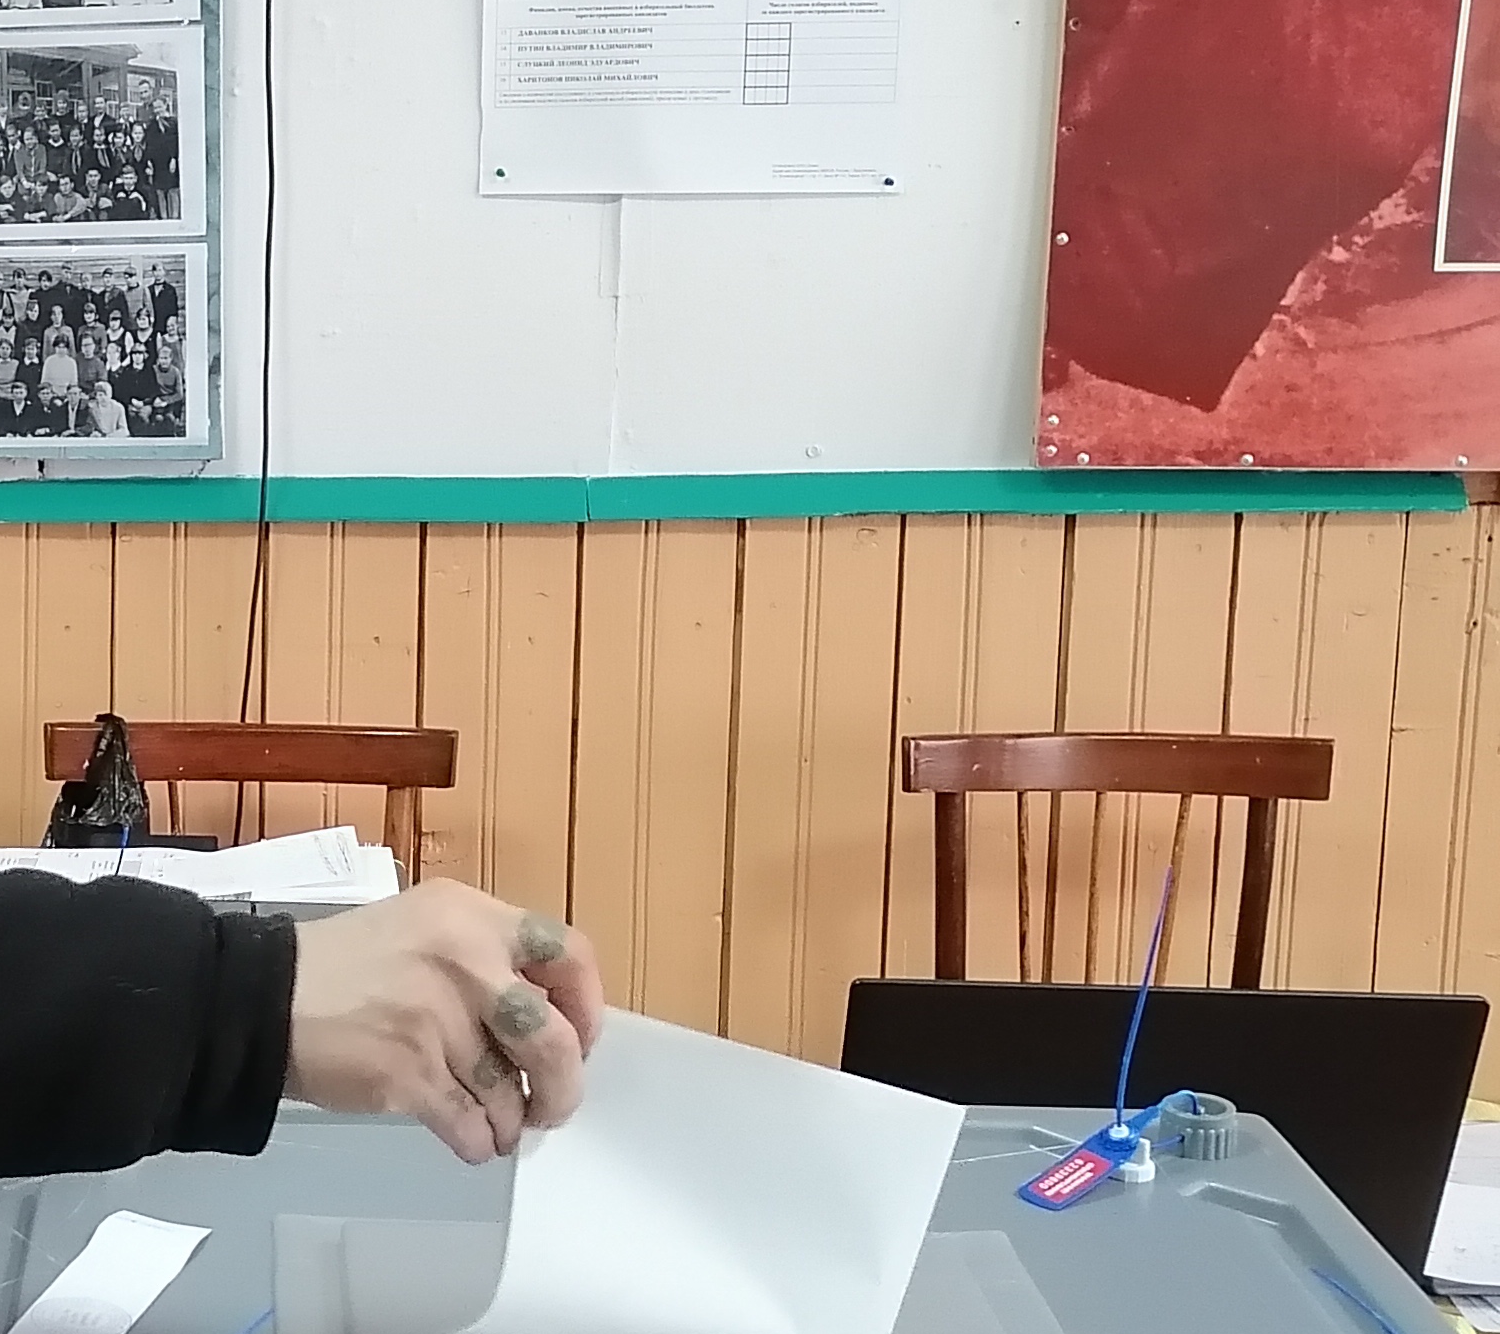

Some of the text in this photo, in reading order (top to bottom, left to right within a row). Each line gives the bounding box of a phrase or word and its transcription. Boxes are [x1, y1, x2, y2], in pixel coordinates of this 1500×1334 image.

[517, 29, 559, 37] ДАВАНКОВ
[517, 43, 654, 52] ПУТИН ВЛАДИМИР ВЛАДИМИРОВИЧ
[517, 60, 555, 68] СЛУЦКИЙ
[517, 74, 659, 84] ХАРИТОНОВ НИКОЛАЙ МИХАЙЛОВИЧ
